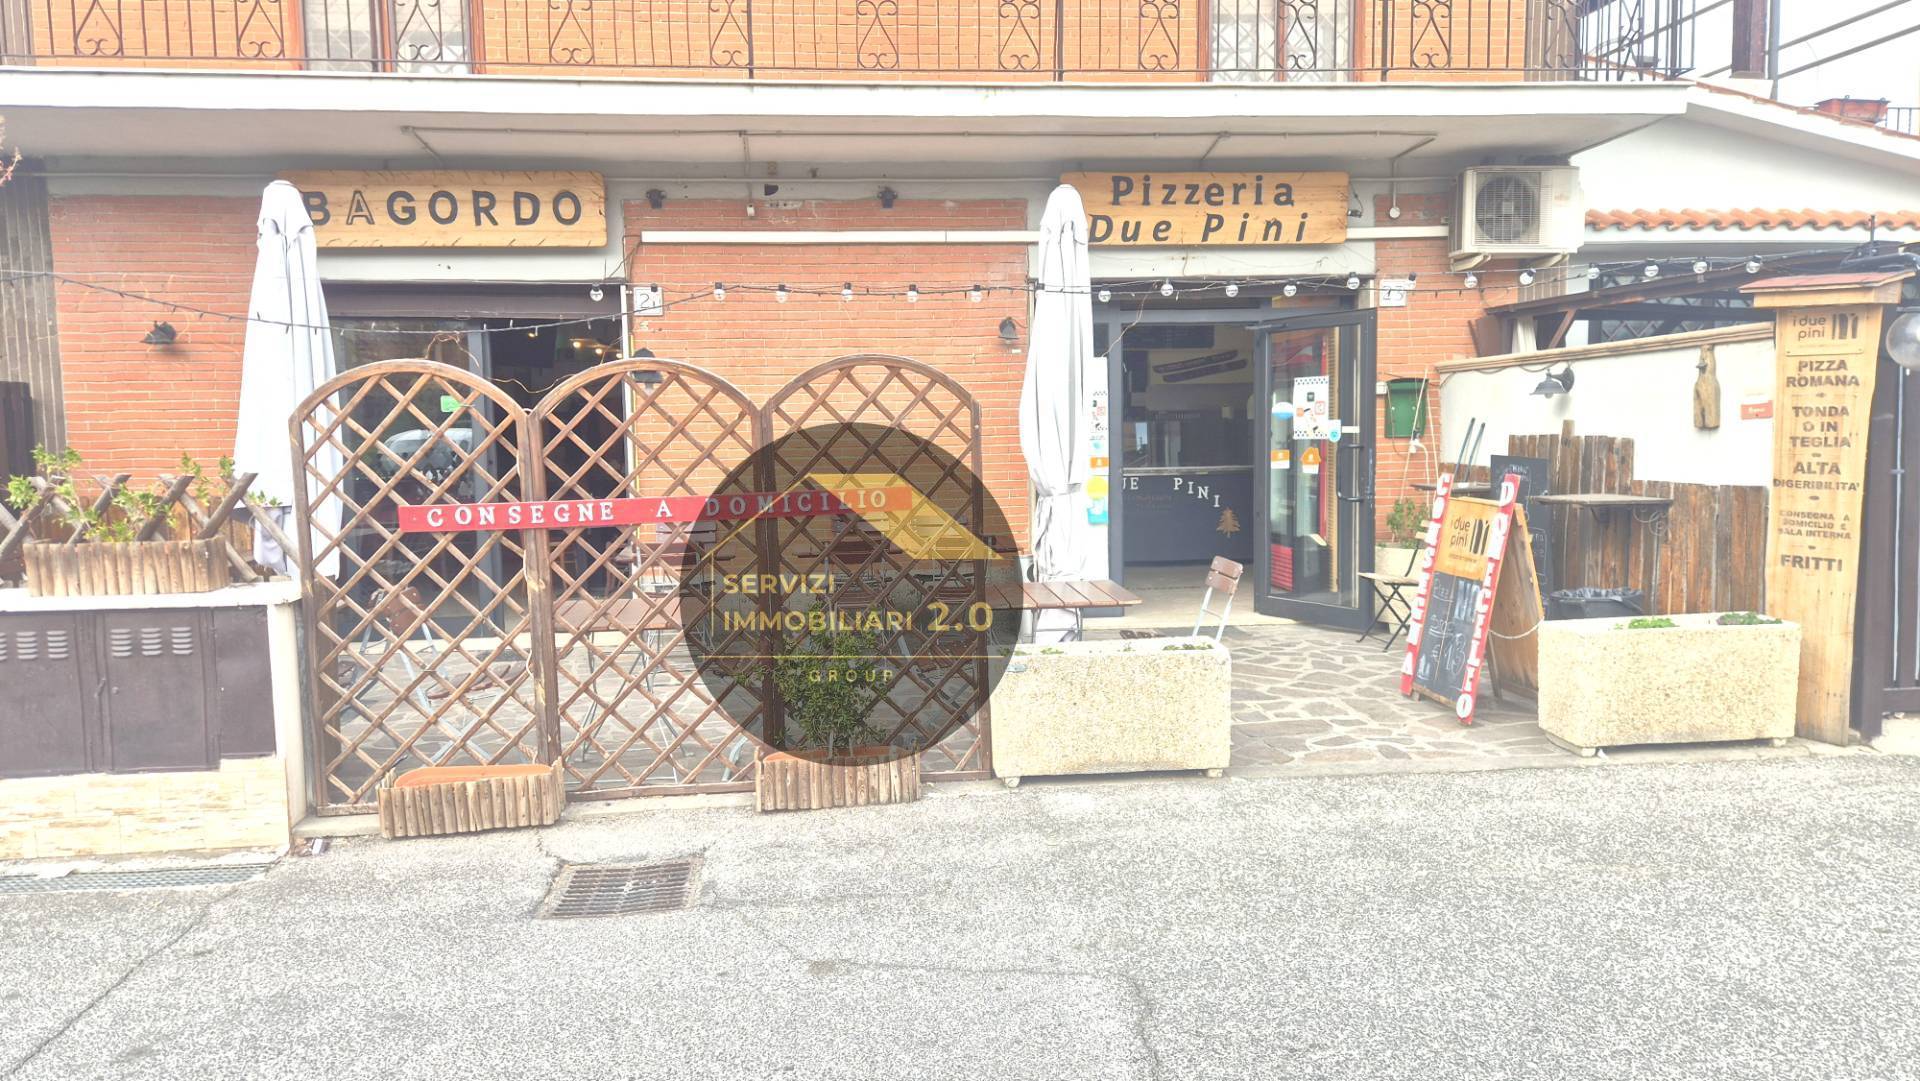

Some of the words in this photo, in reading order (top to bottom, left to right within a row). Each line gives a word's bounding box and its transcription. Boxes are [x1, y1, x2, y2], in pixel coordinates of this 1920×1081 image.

[1111, 174, 1295, 207] Pizzeria
[300, 189, 583, 226] BAGORDO
[1088, 213, 1173, 243] Due
[1201, 212, 1309, 243] Pini
[1799, 314, 1826, 327] due
[1798, 327, 1825, 342] pini
[1798, 360, 1848, 372] PIZZA
[1786, 375, 1860, 388] ROMANA
[1792, 405, 1849, 417] TONDA
[1803, 421, 1815, 432] O
[1820, 421, 1838, 432] IN
[1789, 436, 1851, 448] TEGLIA
[1793, 462, 1841, 475] ALTA
[1173, 477, 1221, 508] PINI
[1773, 479, 1860, 491] DIGERIBILITA'
[426, 501, 614, 527] CONSEGNE
[655, 500, 673, 518] A
[705, 490, 887, 517] DOMICILIO
[1454, 516, 1471, 531] due
[1449, 532, 1469, 547] pini
[1805, 530, 1852, 539] INTERNA
[1780, 554, 1843, 571] FRITTI
[1456, 481, 1515, 719] DOMICILIO
